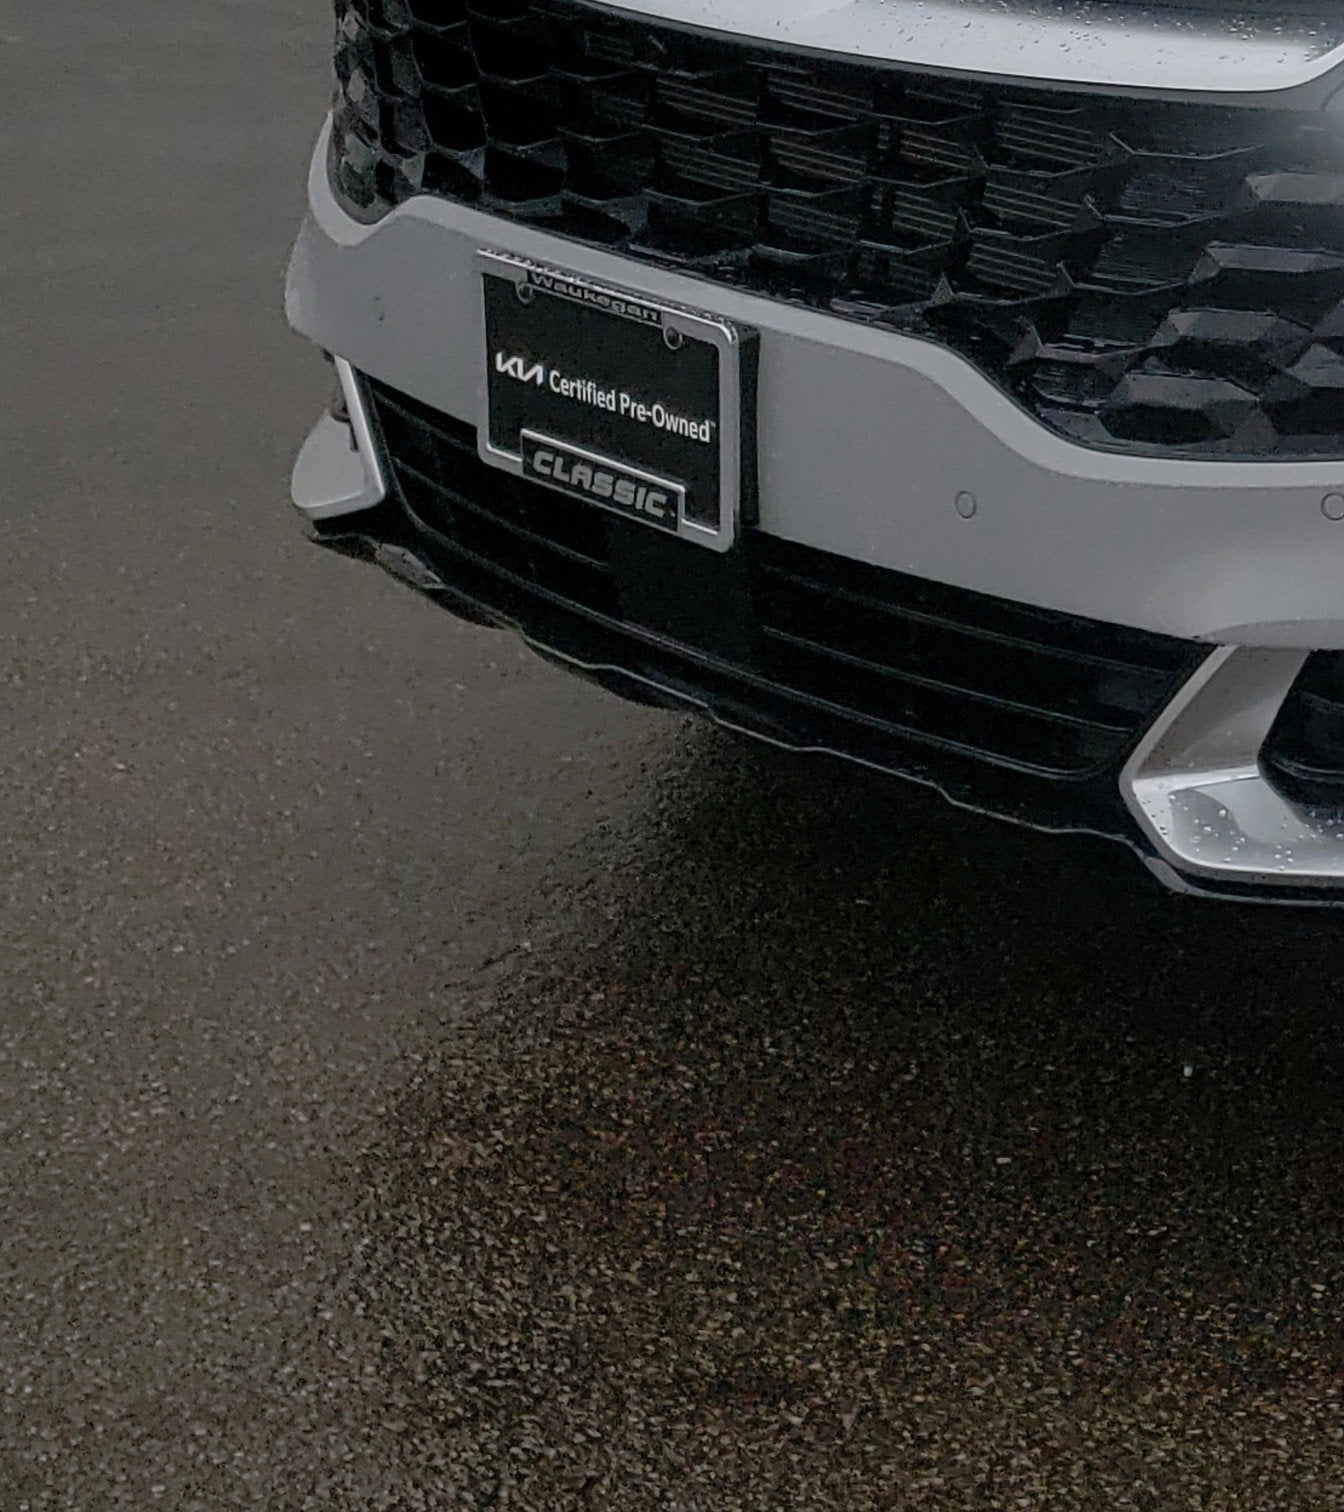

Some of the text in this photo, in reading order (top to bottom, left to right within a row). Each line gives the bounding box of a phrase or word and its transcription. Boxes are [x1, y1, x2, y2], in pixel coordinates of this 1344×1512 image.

[531, 272, 659, 321] Waukegan
[495, 352, 711, 443] KIA Certified Pre-Owned
[533, 450, 667, 518] CLASSIC
